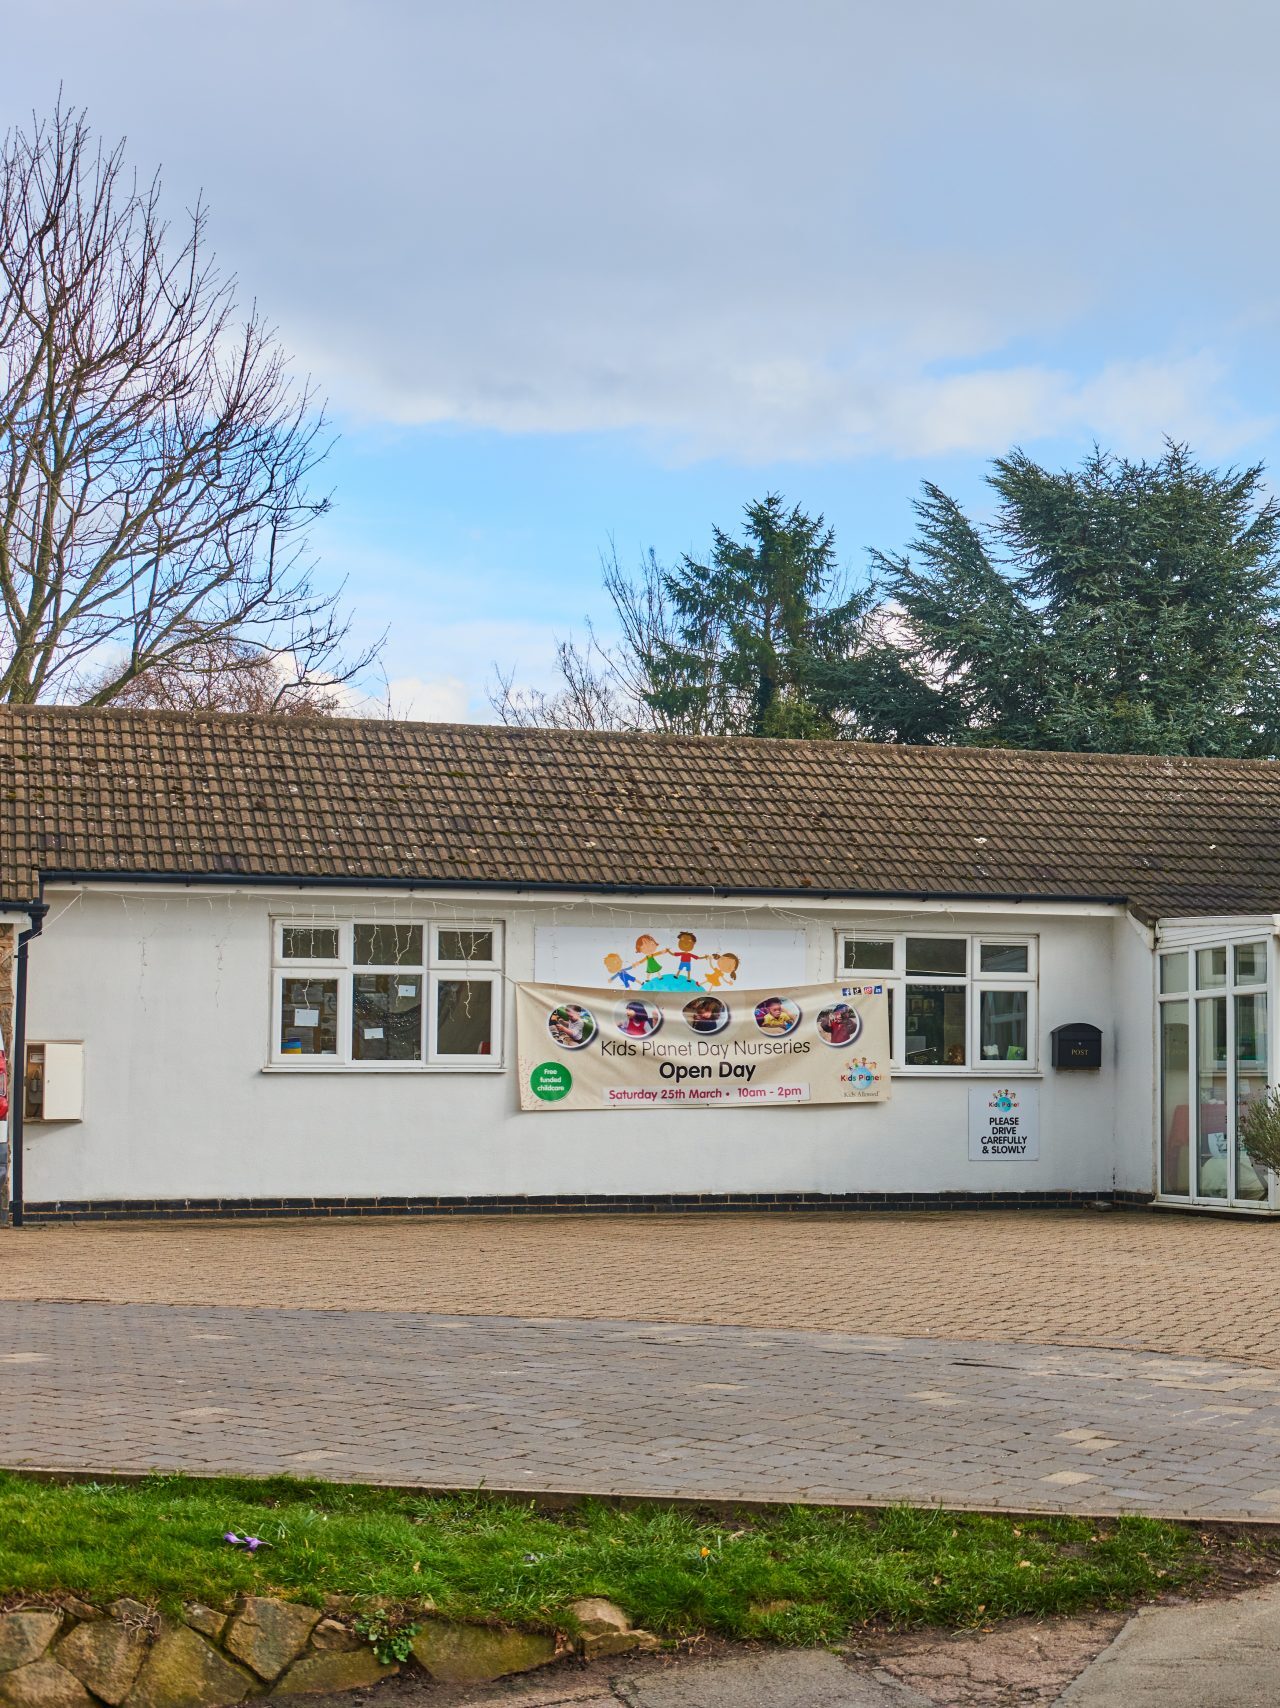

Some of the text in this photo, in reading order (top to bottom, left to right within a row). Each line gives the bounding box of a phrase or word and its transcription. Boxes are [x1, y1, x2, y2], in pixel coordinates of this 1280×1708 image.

[601, 1040, 811, 1059] Kids Planet Day Nurseries
[659, 1061, 756, 1083] Open Day
[609, 1090, 658, 1101] Saturday
[660, 1089, 686, 1099] 25th
[688, 1087, 722, 1099] March
[737, 1087, 766, 1098] 10am
[777, 1086, 802, 1098] 2pm
[989, 1117, 1020, 1125] PLEASE
[992, 1126, 1017, 1135] DRIVE
[980, 1136, 1028, 1145] CAREFULLY
[982, 1145, 1027, 1154] & SLOWLY
